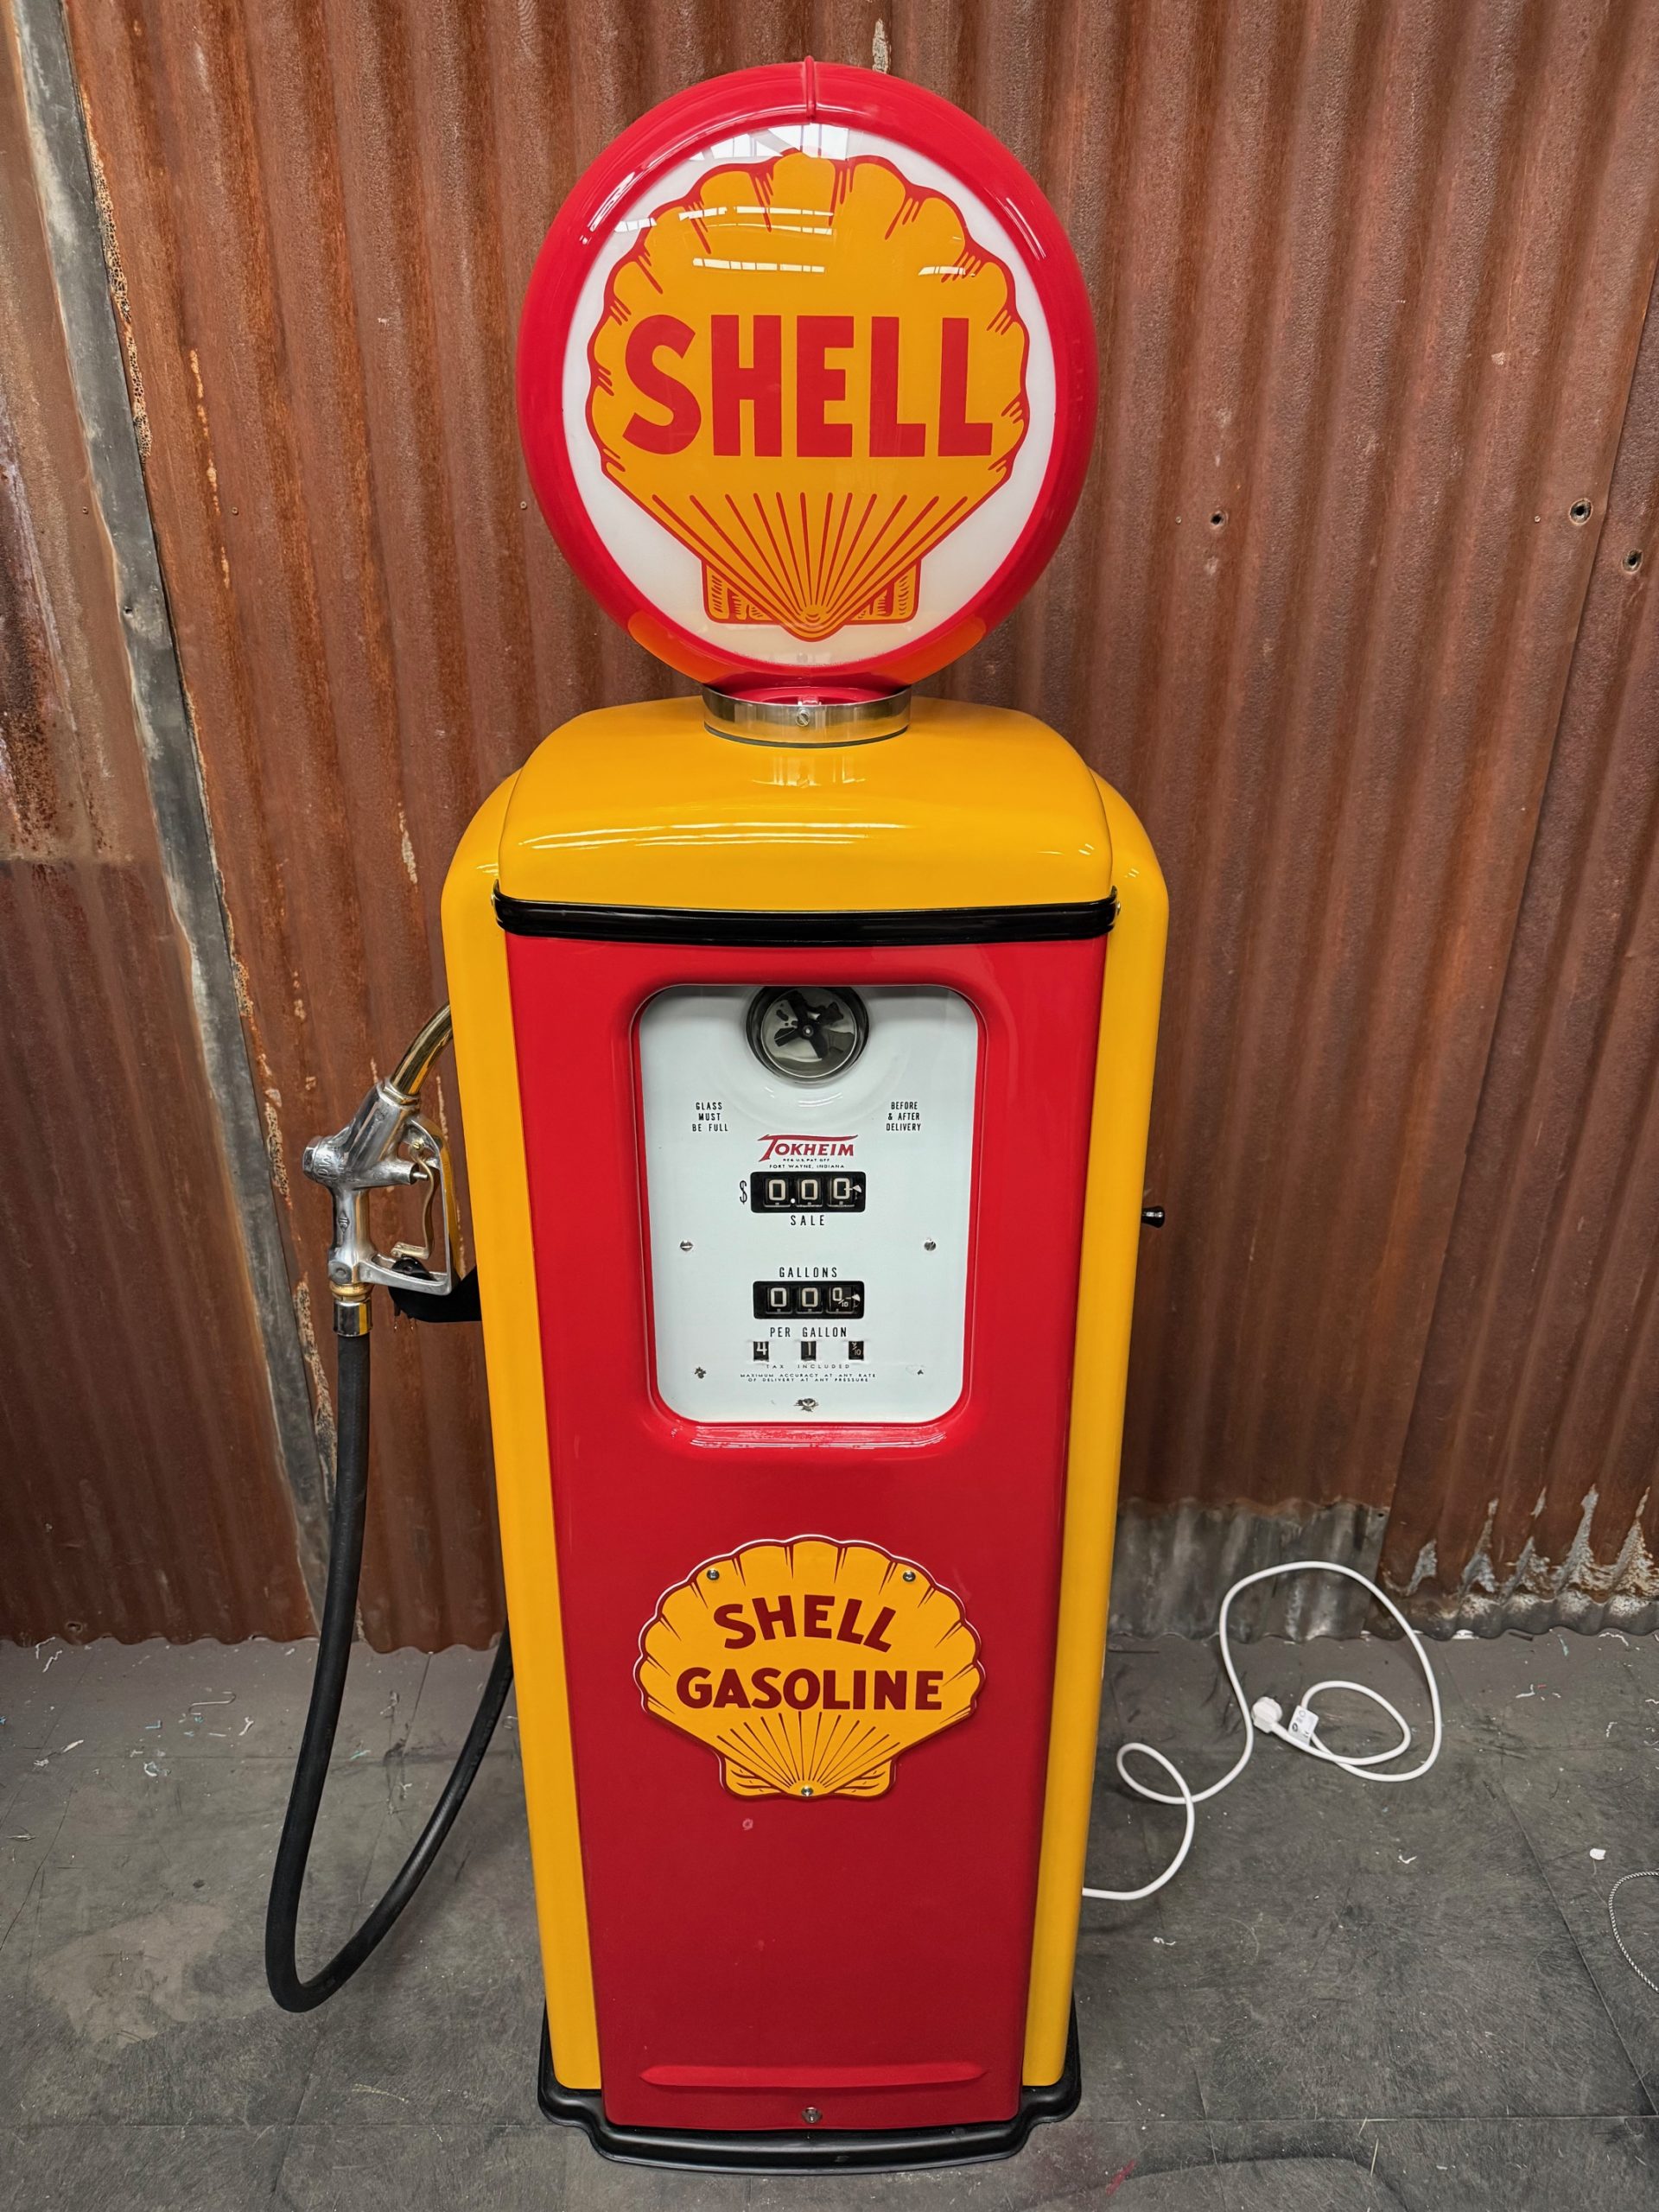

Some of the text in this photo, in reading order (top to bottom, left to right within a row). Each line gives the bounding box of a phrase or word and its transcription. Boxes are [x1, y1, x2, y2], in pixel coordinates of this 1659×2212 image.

[622, 314, 994, 458] SHELL
[696, 1102, 723, 1110] GLASS
[891, 1101, 918, 1110] BEFORE
[698, 1112, 721, 1121] MUST
[887, 1112, 920, 1121] & AFTER
[692, 1123, 728, 1132] BE FULL
[886, 1122, 921, 1131] DELIVERY
[757, 1134, 859, 1162] TOKHEIM
[740, 1180, 747, 1205] $
[791, 1215, 825, 1226] SALE
[779, 1267, 837, 1278] GALLONS
[770, 1327, 847, 1338] PER GALLON
[756, 1342, 767, 1355] 4
[807, 1341, 812, 1356] 1
[714, 1594, 897, 1653] SHELL
[676, 1667, 944, 1711] GASOLINE
